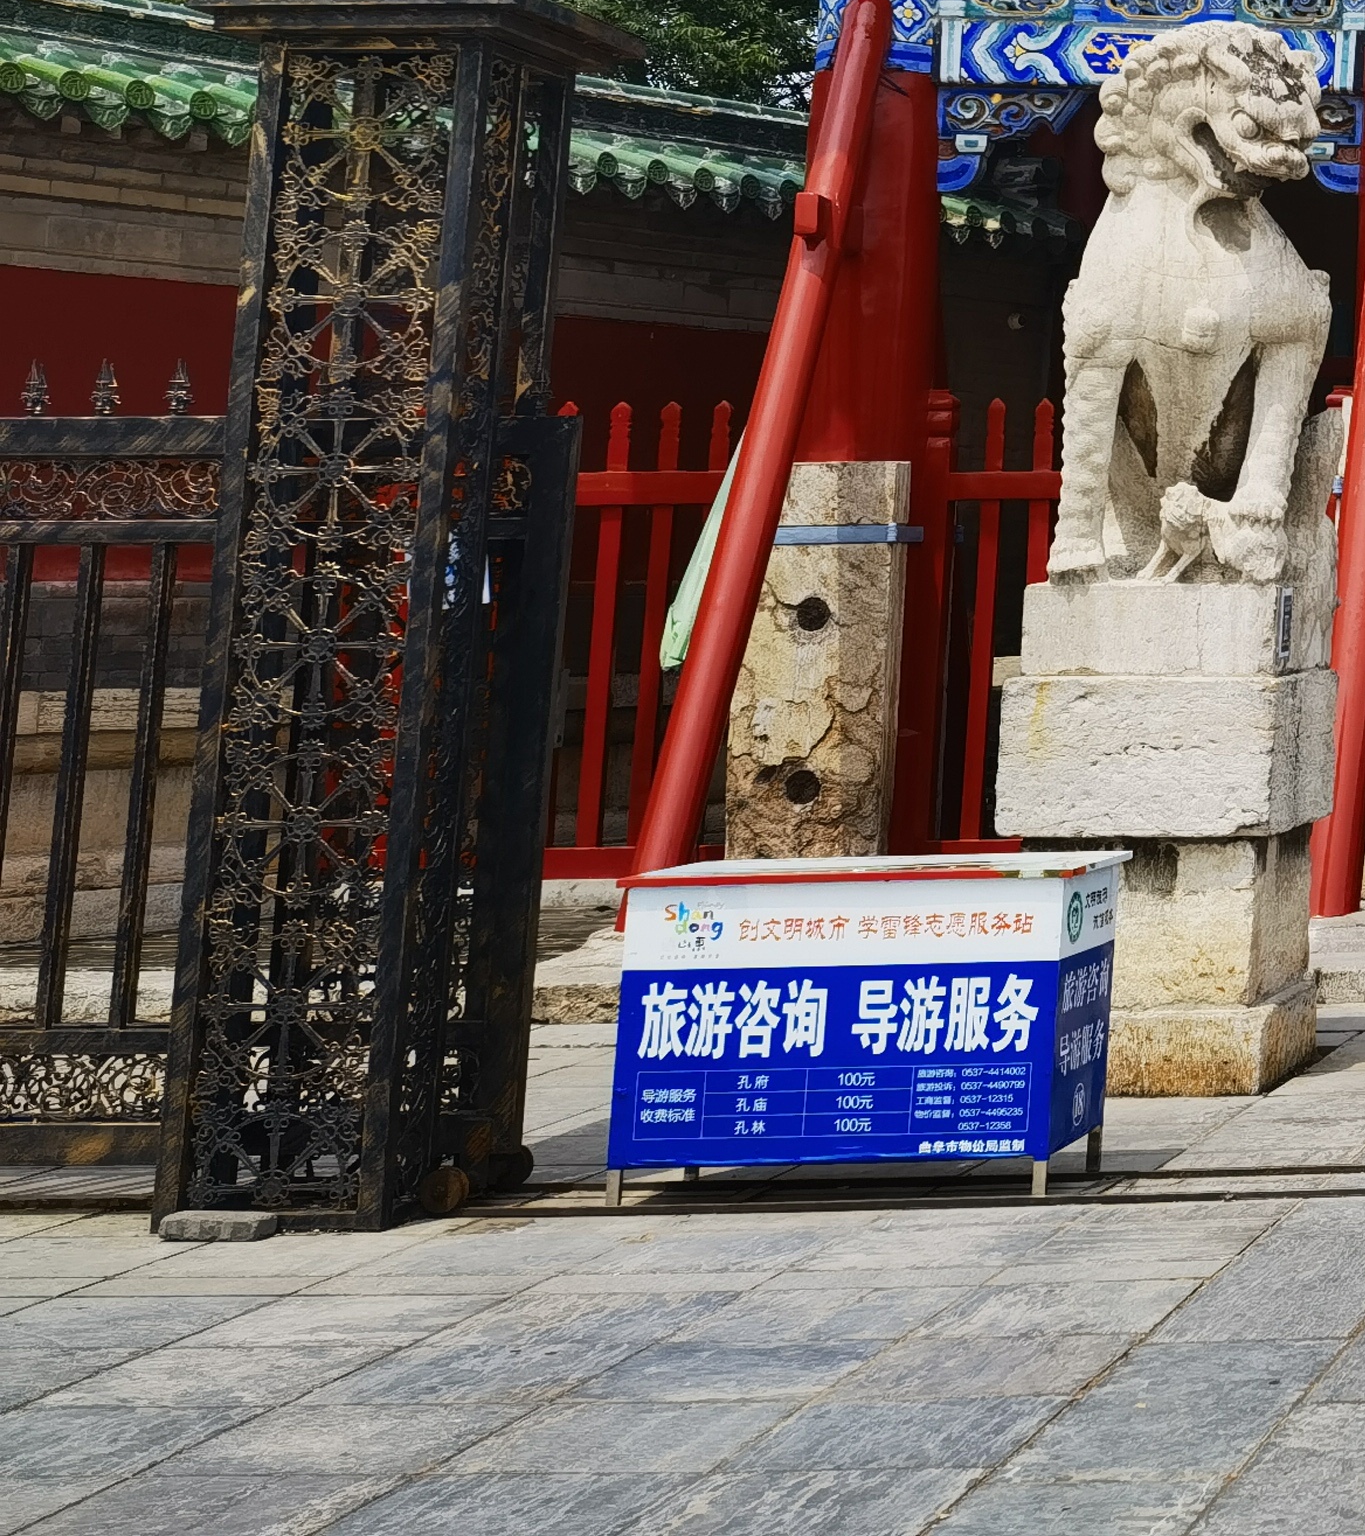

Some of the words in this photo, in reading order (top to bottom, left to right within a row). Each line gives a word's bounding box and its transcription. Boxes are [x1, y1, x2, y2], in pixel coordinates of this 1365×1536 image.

[664, 901, 714, 921] Shan
[675, 921, 723, 941] dong
[738, 917, 850, 942] 创文明城市
[858, 912, 1034, 939] 学雷锋志愿服务站
[1061, 958, 1110, 1013] 旅游咨询
[636, 979, 829, 1060] 旅游咨询
[851, 973, 1040, 1056] 导游服务
[1058, 1018, 1105, 1076] 导游服务
[837, 1072, 876, 1086] 100元
[641, 1088, 697, 1103] 导游服务
[835, 1095, 874, 1110] 100元
[640, 1108, 696, 1123] 收费标准
[833, 1118, 872, 1133] 100元
